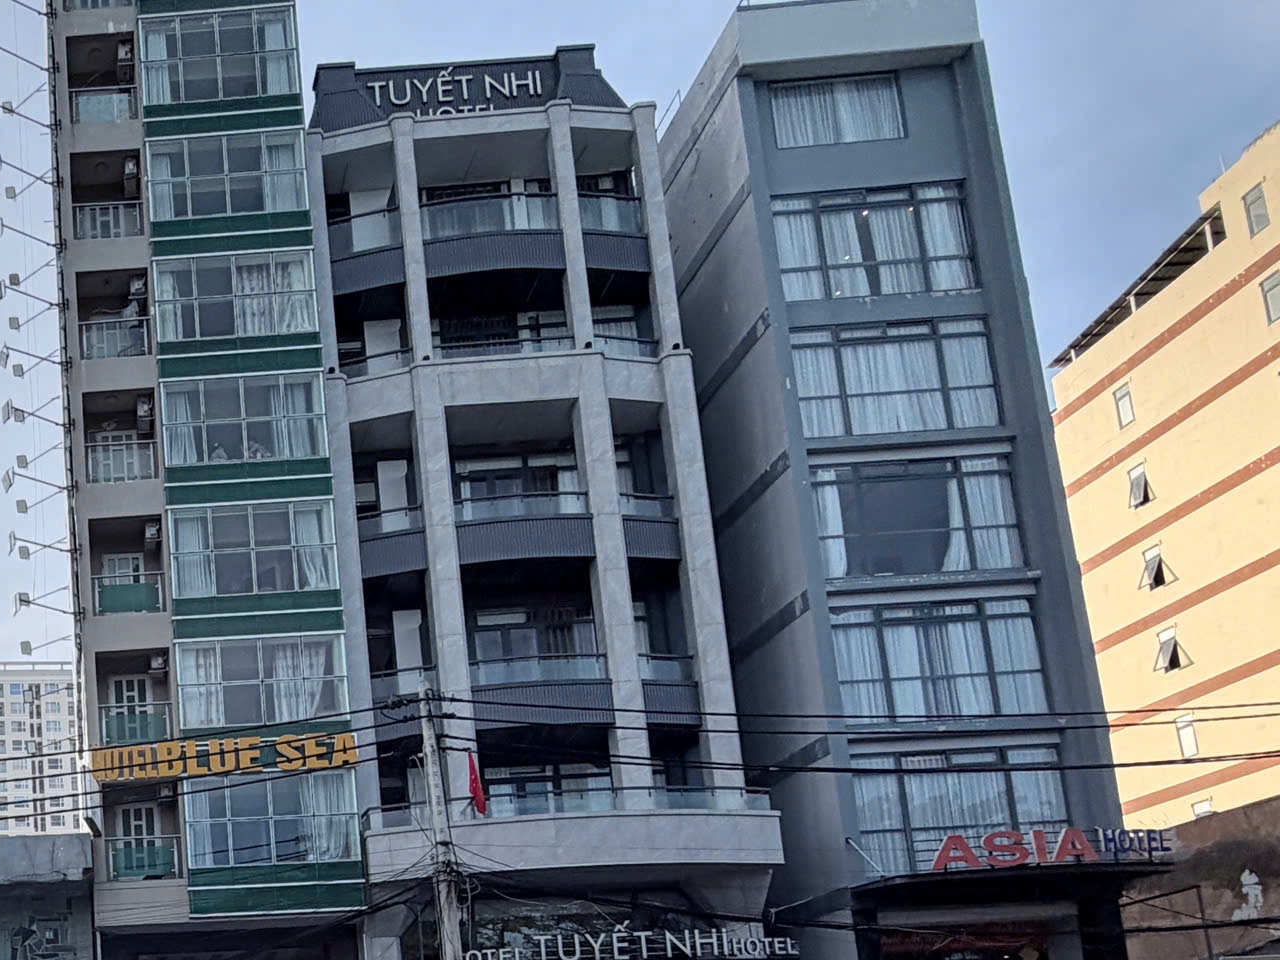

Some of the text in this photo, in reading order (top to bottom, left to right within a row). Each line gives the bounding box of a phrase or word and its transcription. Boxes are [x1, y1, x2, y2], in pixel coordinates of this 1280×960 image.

[367, 67, 542, 106] TUYẾT NHI
[92, 732, 359, 780] HOTEL BLUE SEA
[930, 826, 1173, 871] ASIA HOTEL
[664, 928, 728, 958] NHI
[732, 937, 800, 955] HOTEL
